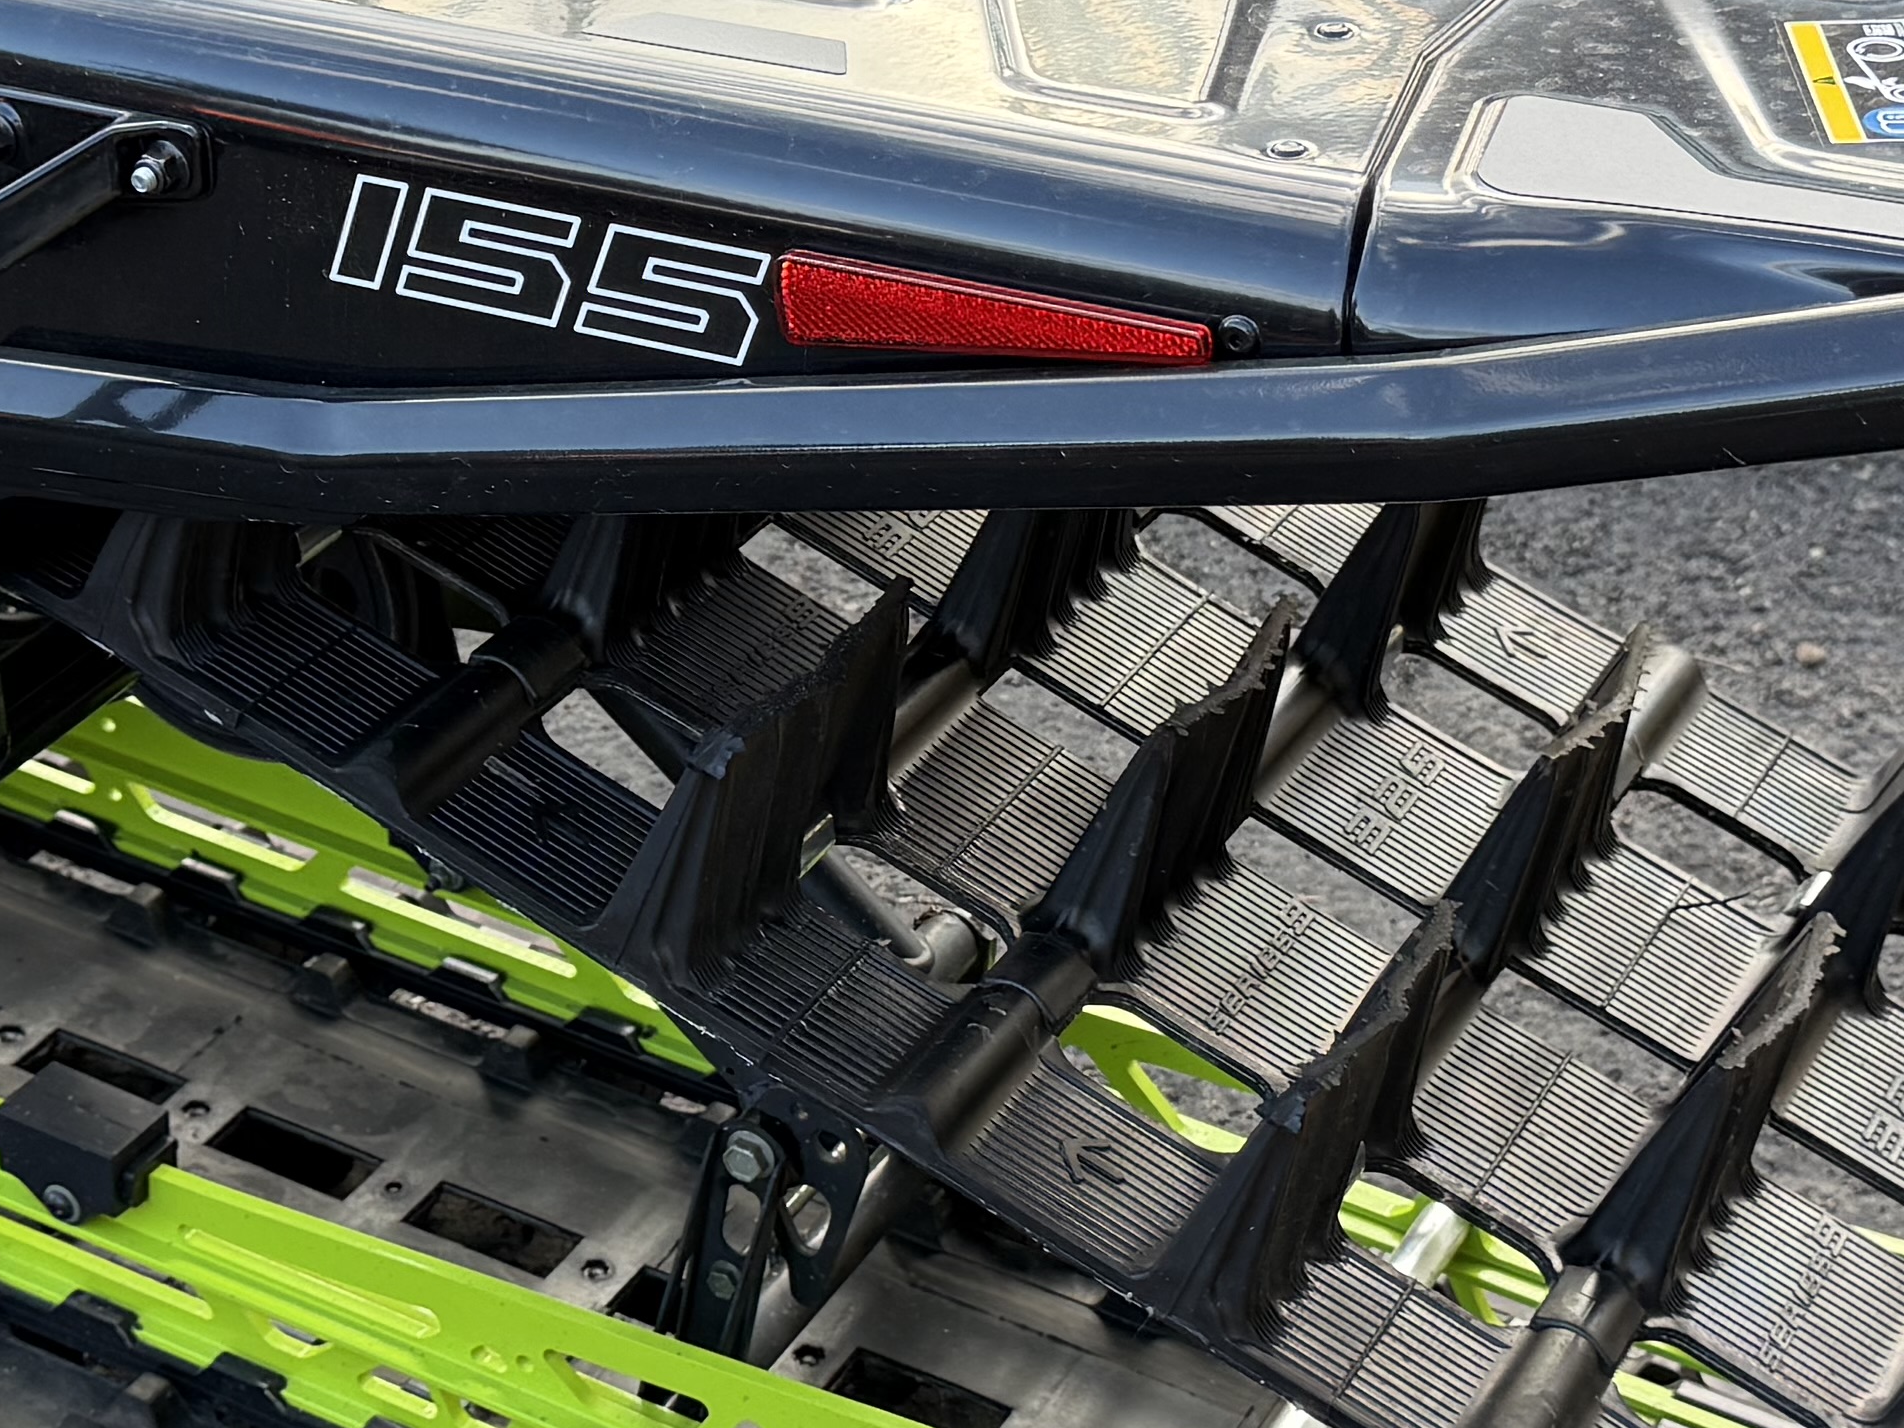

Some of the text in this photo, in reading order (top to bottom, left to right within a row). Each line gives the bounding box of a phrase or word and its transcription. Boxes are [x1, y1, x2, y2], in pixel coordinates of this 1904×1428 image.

[329, 173, 771, 367] 155
[1205, 929, 1295, 1036] SERIES
[1759, 1252, 1834, 1373] SERIES
